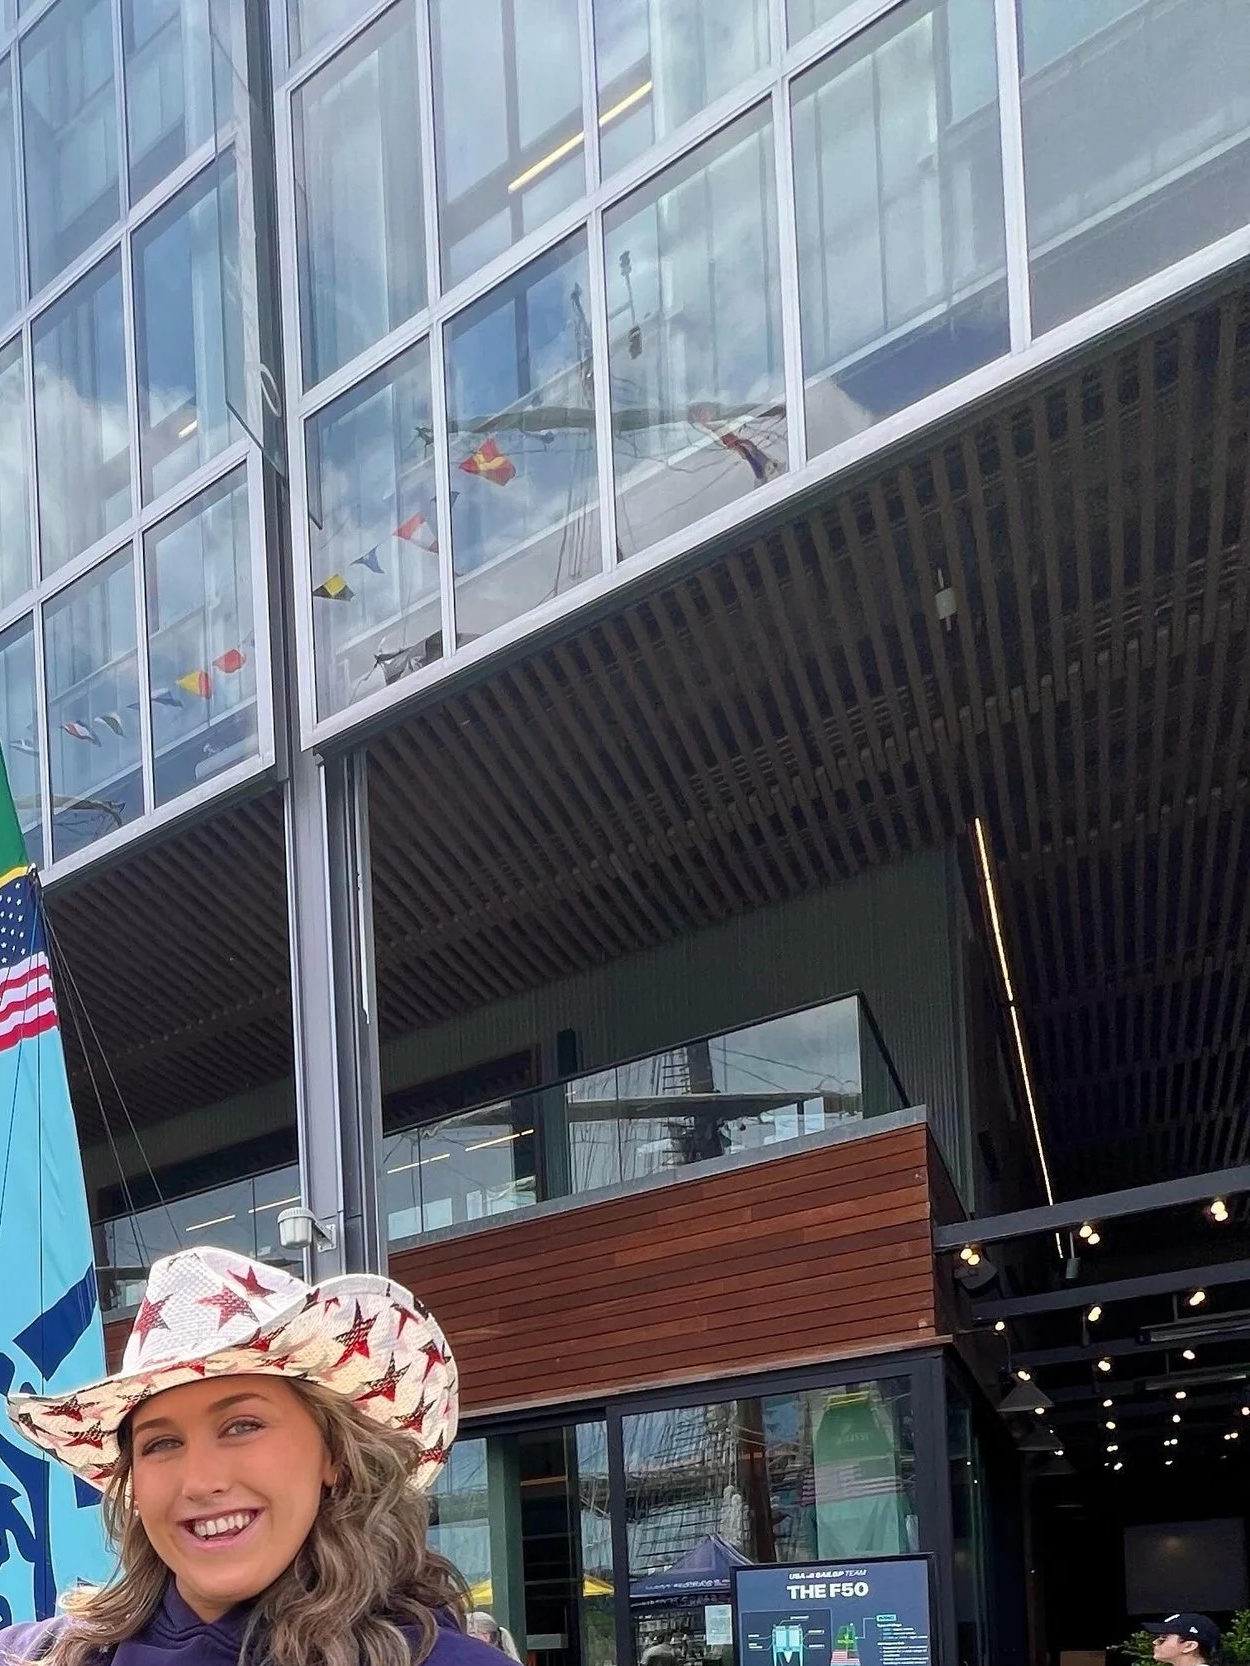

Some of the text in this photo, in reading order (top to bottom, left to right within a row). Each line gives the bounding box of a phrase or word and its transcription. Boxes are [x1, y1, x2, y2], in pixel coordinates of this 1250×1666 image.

[845, 1569, 867, 1577] TEAM
[786, 1581, 869, 1600] THE F50
